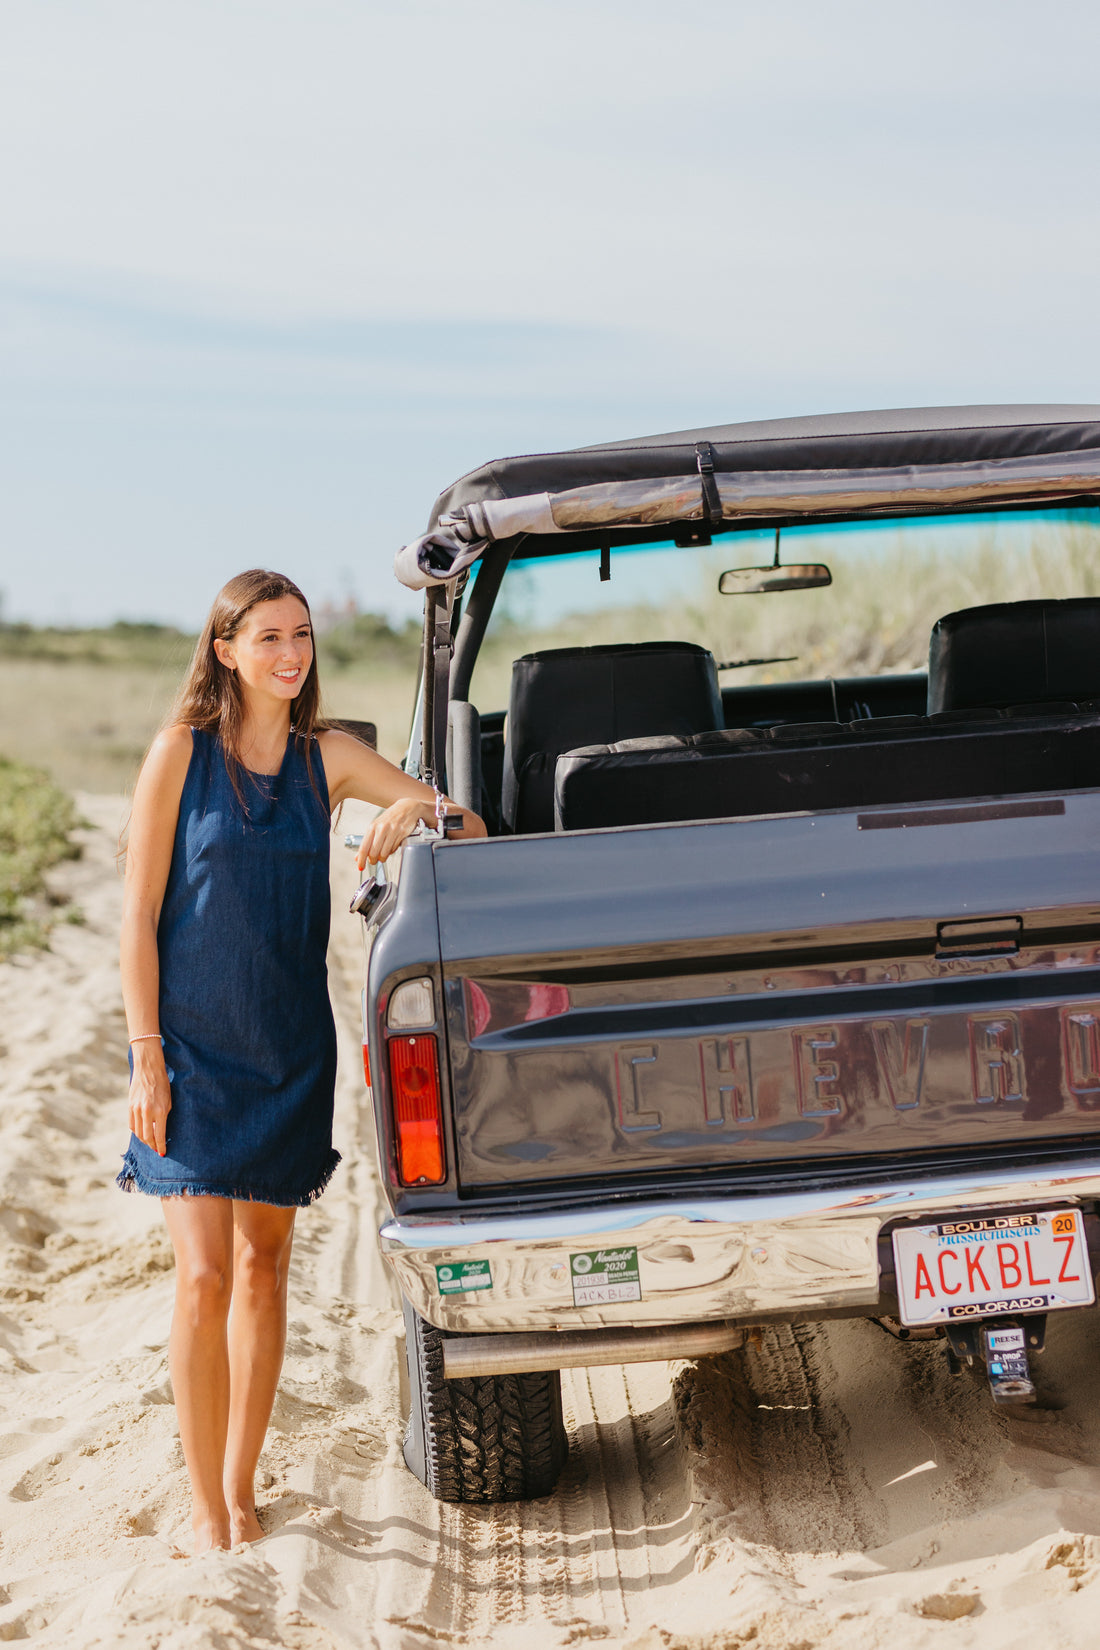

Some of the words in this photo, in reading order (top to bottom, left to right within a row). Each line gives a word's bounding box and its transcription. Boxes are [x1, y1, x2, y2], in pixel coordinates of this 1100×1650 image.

[941, 1215, 1033, 1235] BOULDER
[1055, 1218, 1073, 1232] 20
[593, 1249, 636, 1264] Nantucket
[603, 1261, 627, 1272] 2020
[914, 1235, 1080, 1300] ACKBLZ
[952, 1296, 1045, 1317] COLORADO
[994, 1334, 1021, 1344] REESE
